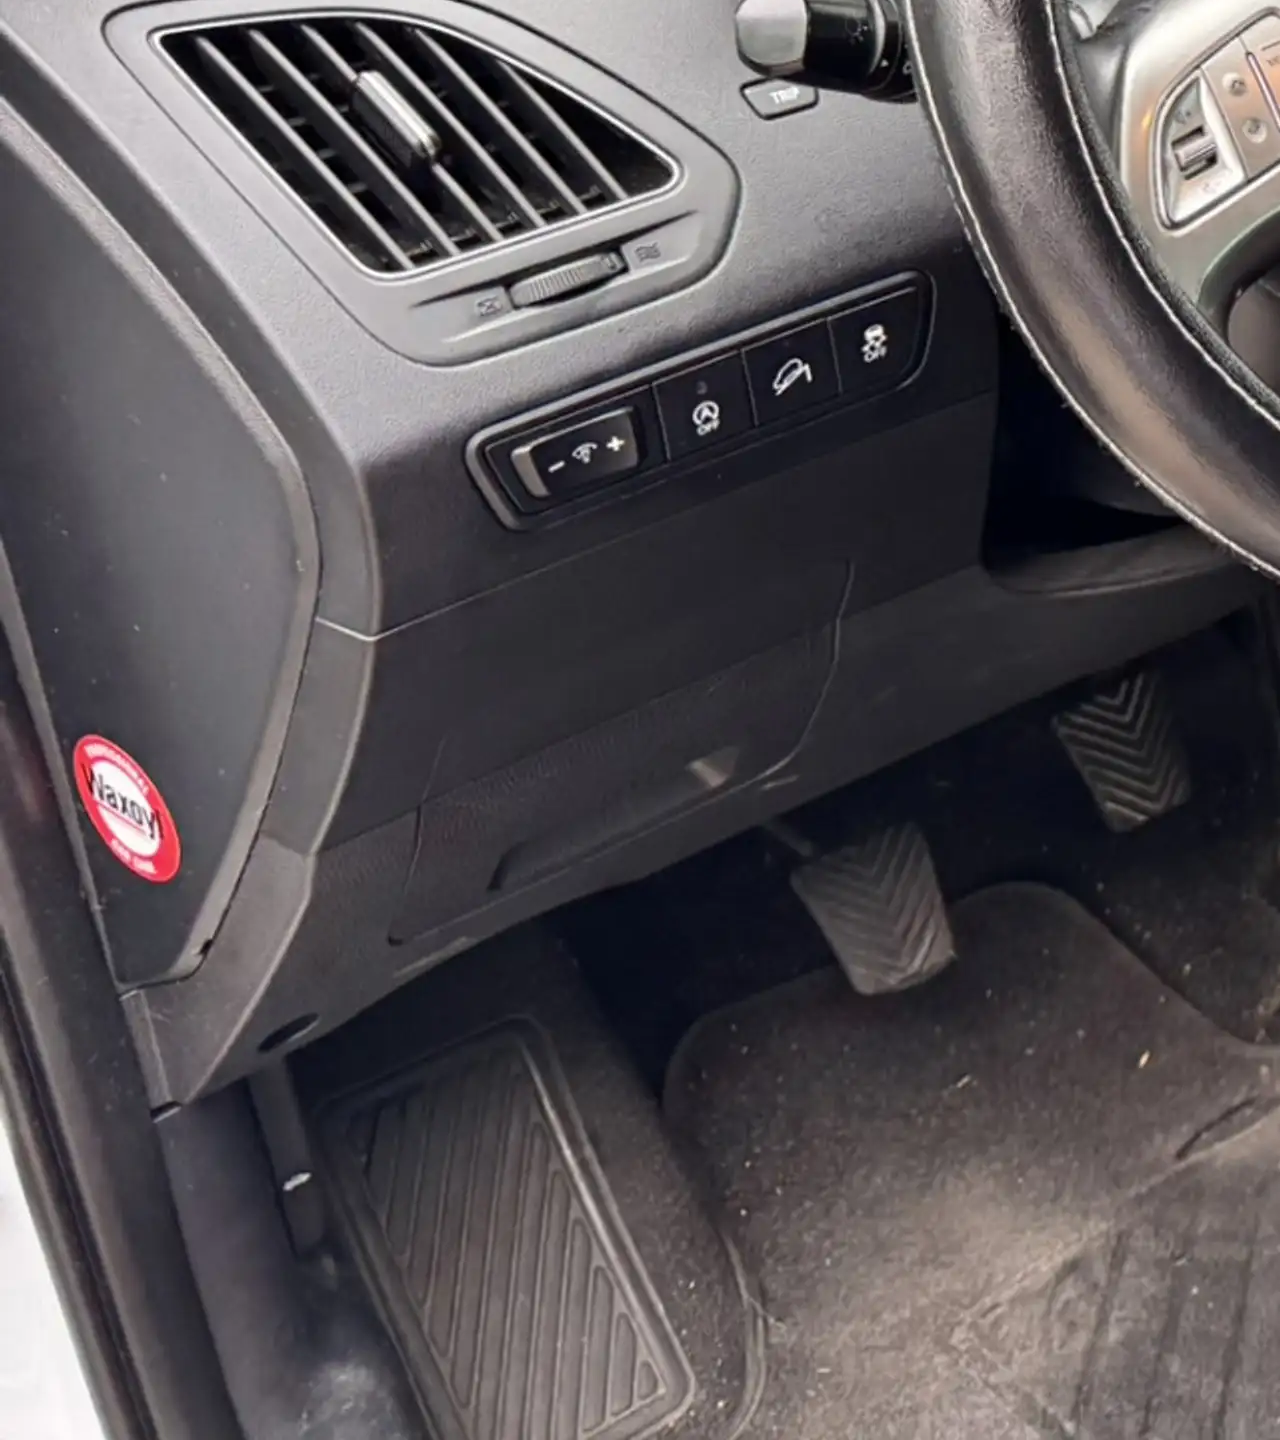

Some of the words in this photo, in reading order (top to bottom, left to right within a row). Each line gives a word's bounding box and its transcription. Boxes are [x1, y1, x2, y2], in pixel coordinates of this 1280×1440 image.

[769, 86, 799, 104] TRIP
[864, 344, 888, 363] OFF
[696, 418, 721, 436] OFF
[80, 763, 164, 840] Waxoyl
